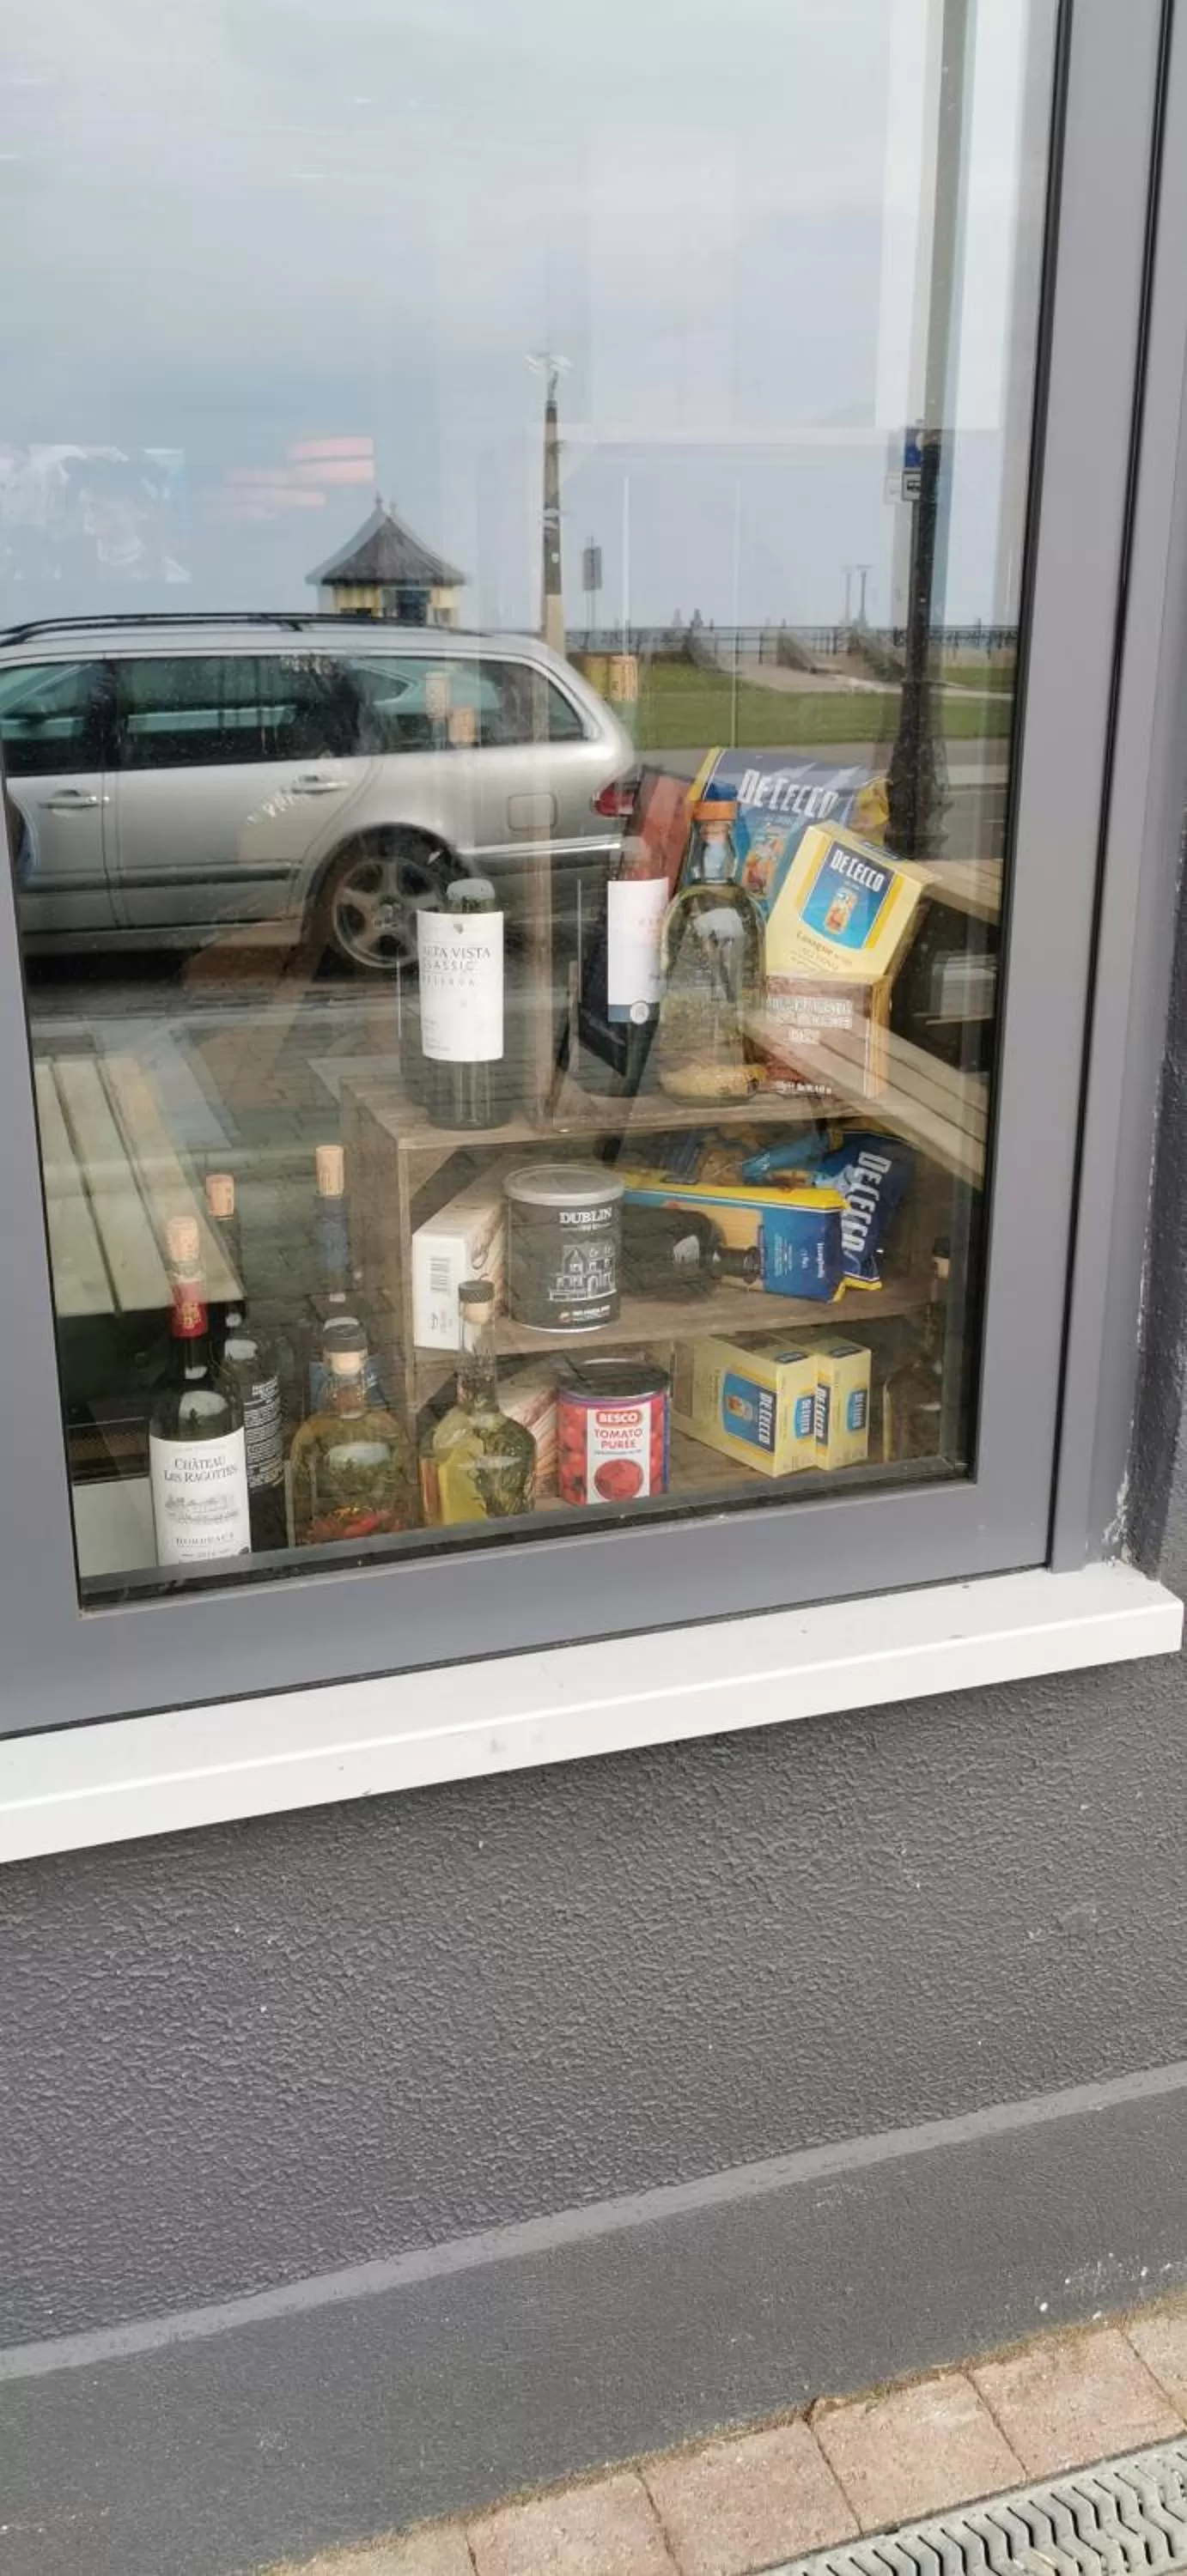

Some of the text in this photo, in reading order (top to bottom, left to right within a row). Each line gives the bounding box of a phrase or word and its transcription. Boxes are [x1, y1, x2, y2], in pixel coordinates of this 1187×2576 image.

[452, 947, 490, 959] VISTA
[560, 1207, 612, 1224] DUBLIN
[594, 1428, 642, 1438] TOMATO
